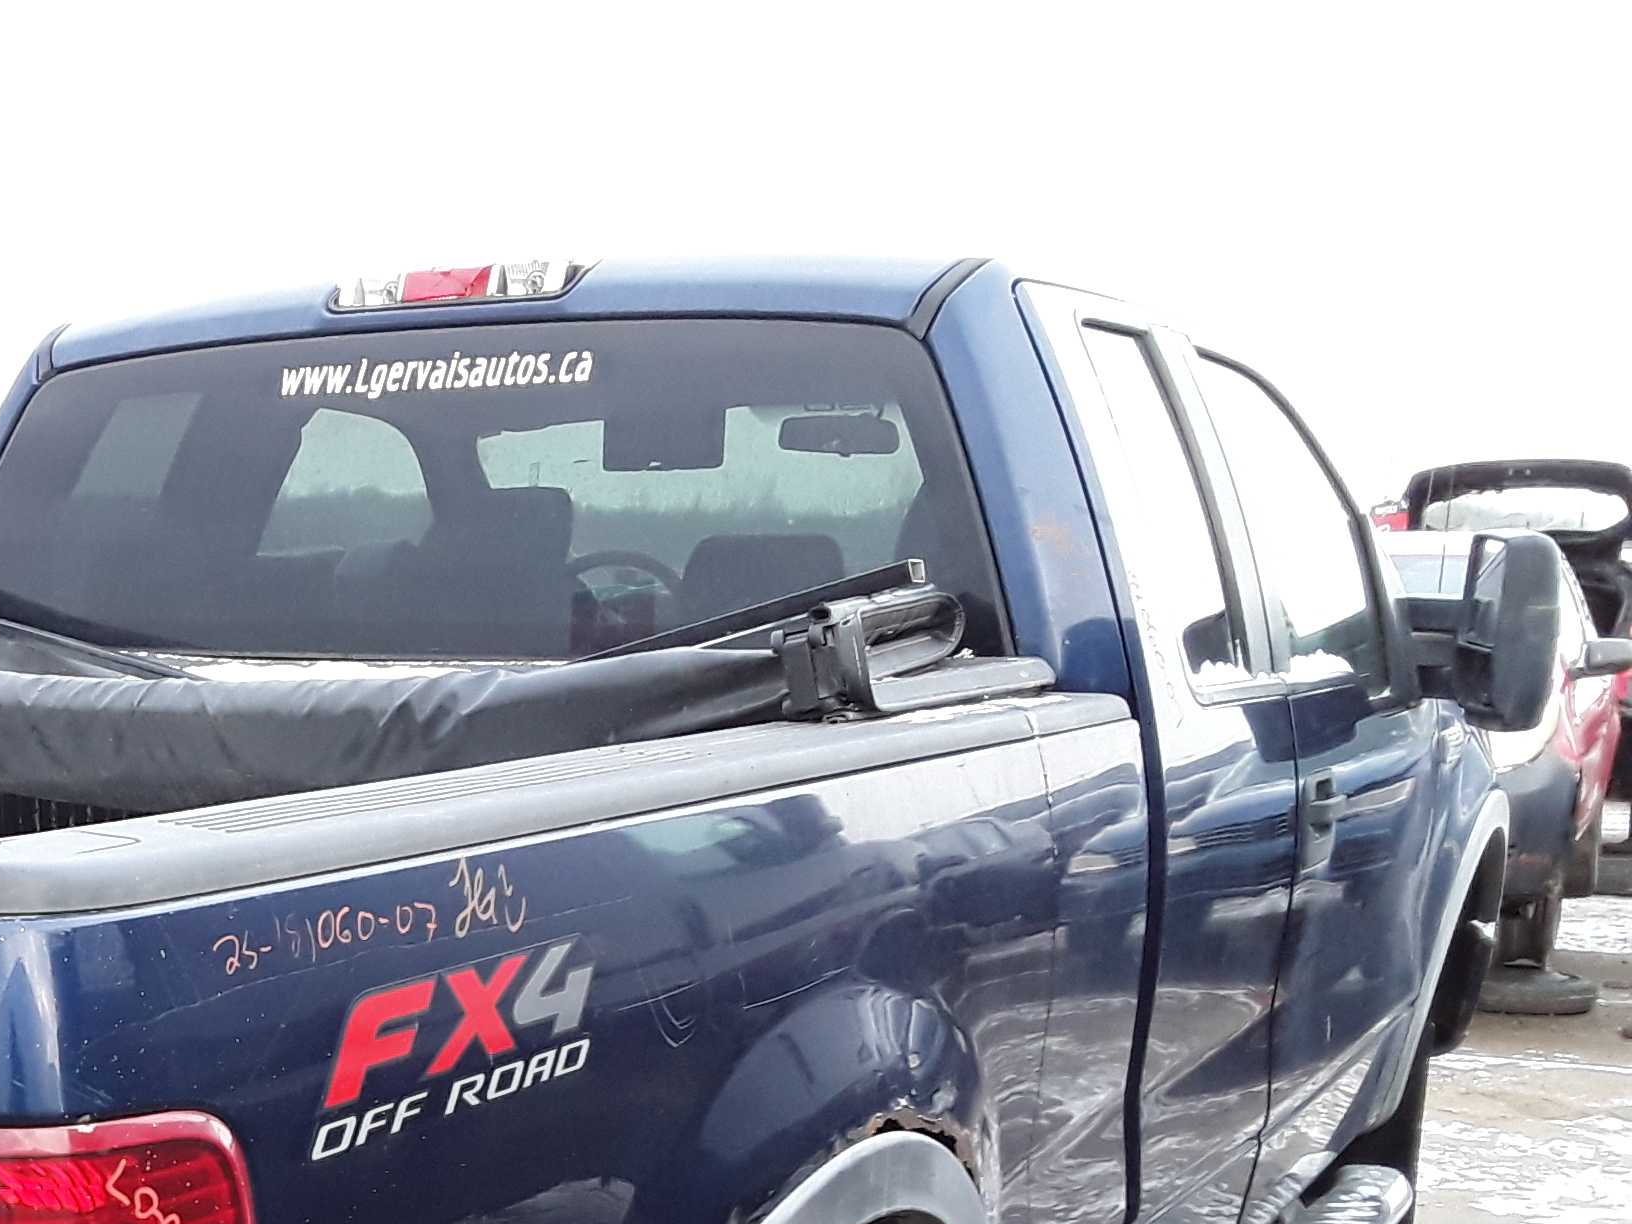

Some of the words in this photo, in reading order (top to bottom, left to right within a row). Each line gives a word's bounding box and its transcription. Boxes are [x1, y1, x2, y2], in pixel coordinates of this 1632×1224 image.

[280, 350, 594, 400] www.Lgervaisautos.ca
[323, 941, 594, 1109] FX4
[310, 1090, 429, 1162] OFF
[444, 1037, 591, 1117] ROAD
